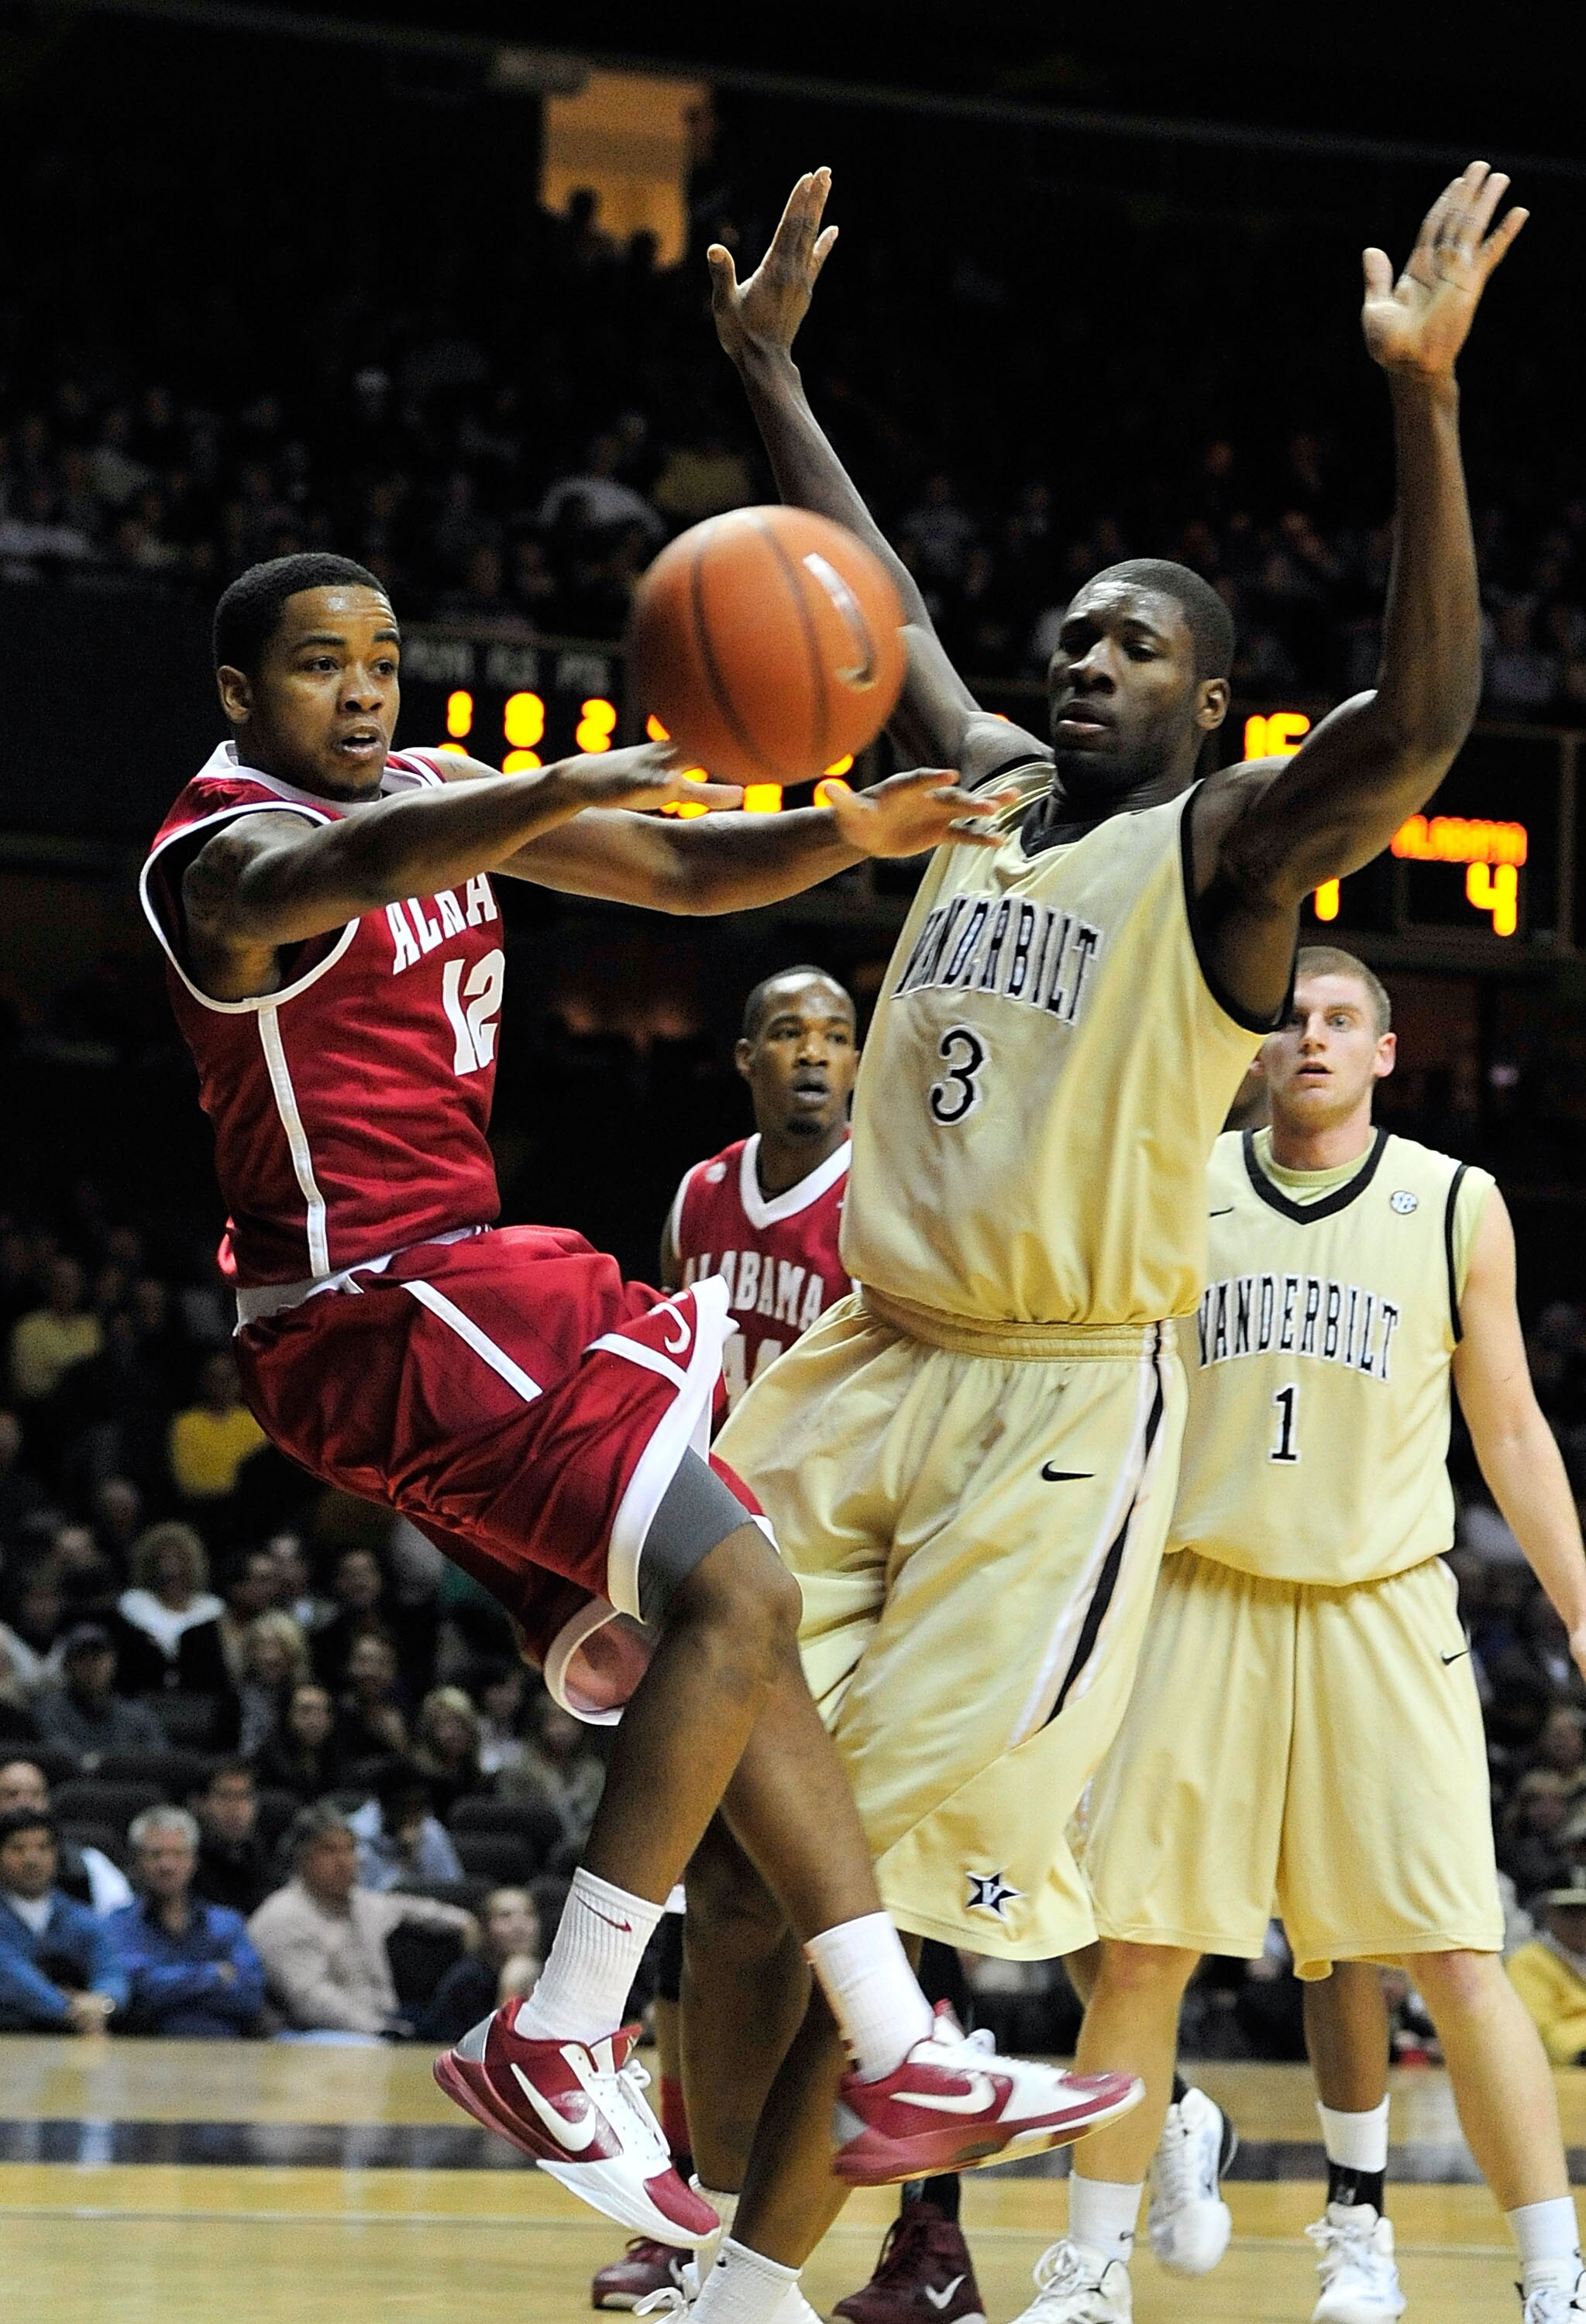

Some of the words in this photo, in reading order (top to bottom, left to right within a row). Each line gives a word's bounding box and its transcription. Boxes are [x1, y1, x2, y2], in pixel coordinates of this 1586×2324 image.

[1466, 861, 1519, 937] 4
[442, 948, 505, 1076] 12
[931, 1024, 993, 1126] 3
[1198, 1273, 1401, 1386] VANDERBILT
[1268, 1382, 1303, 1465] 1
